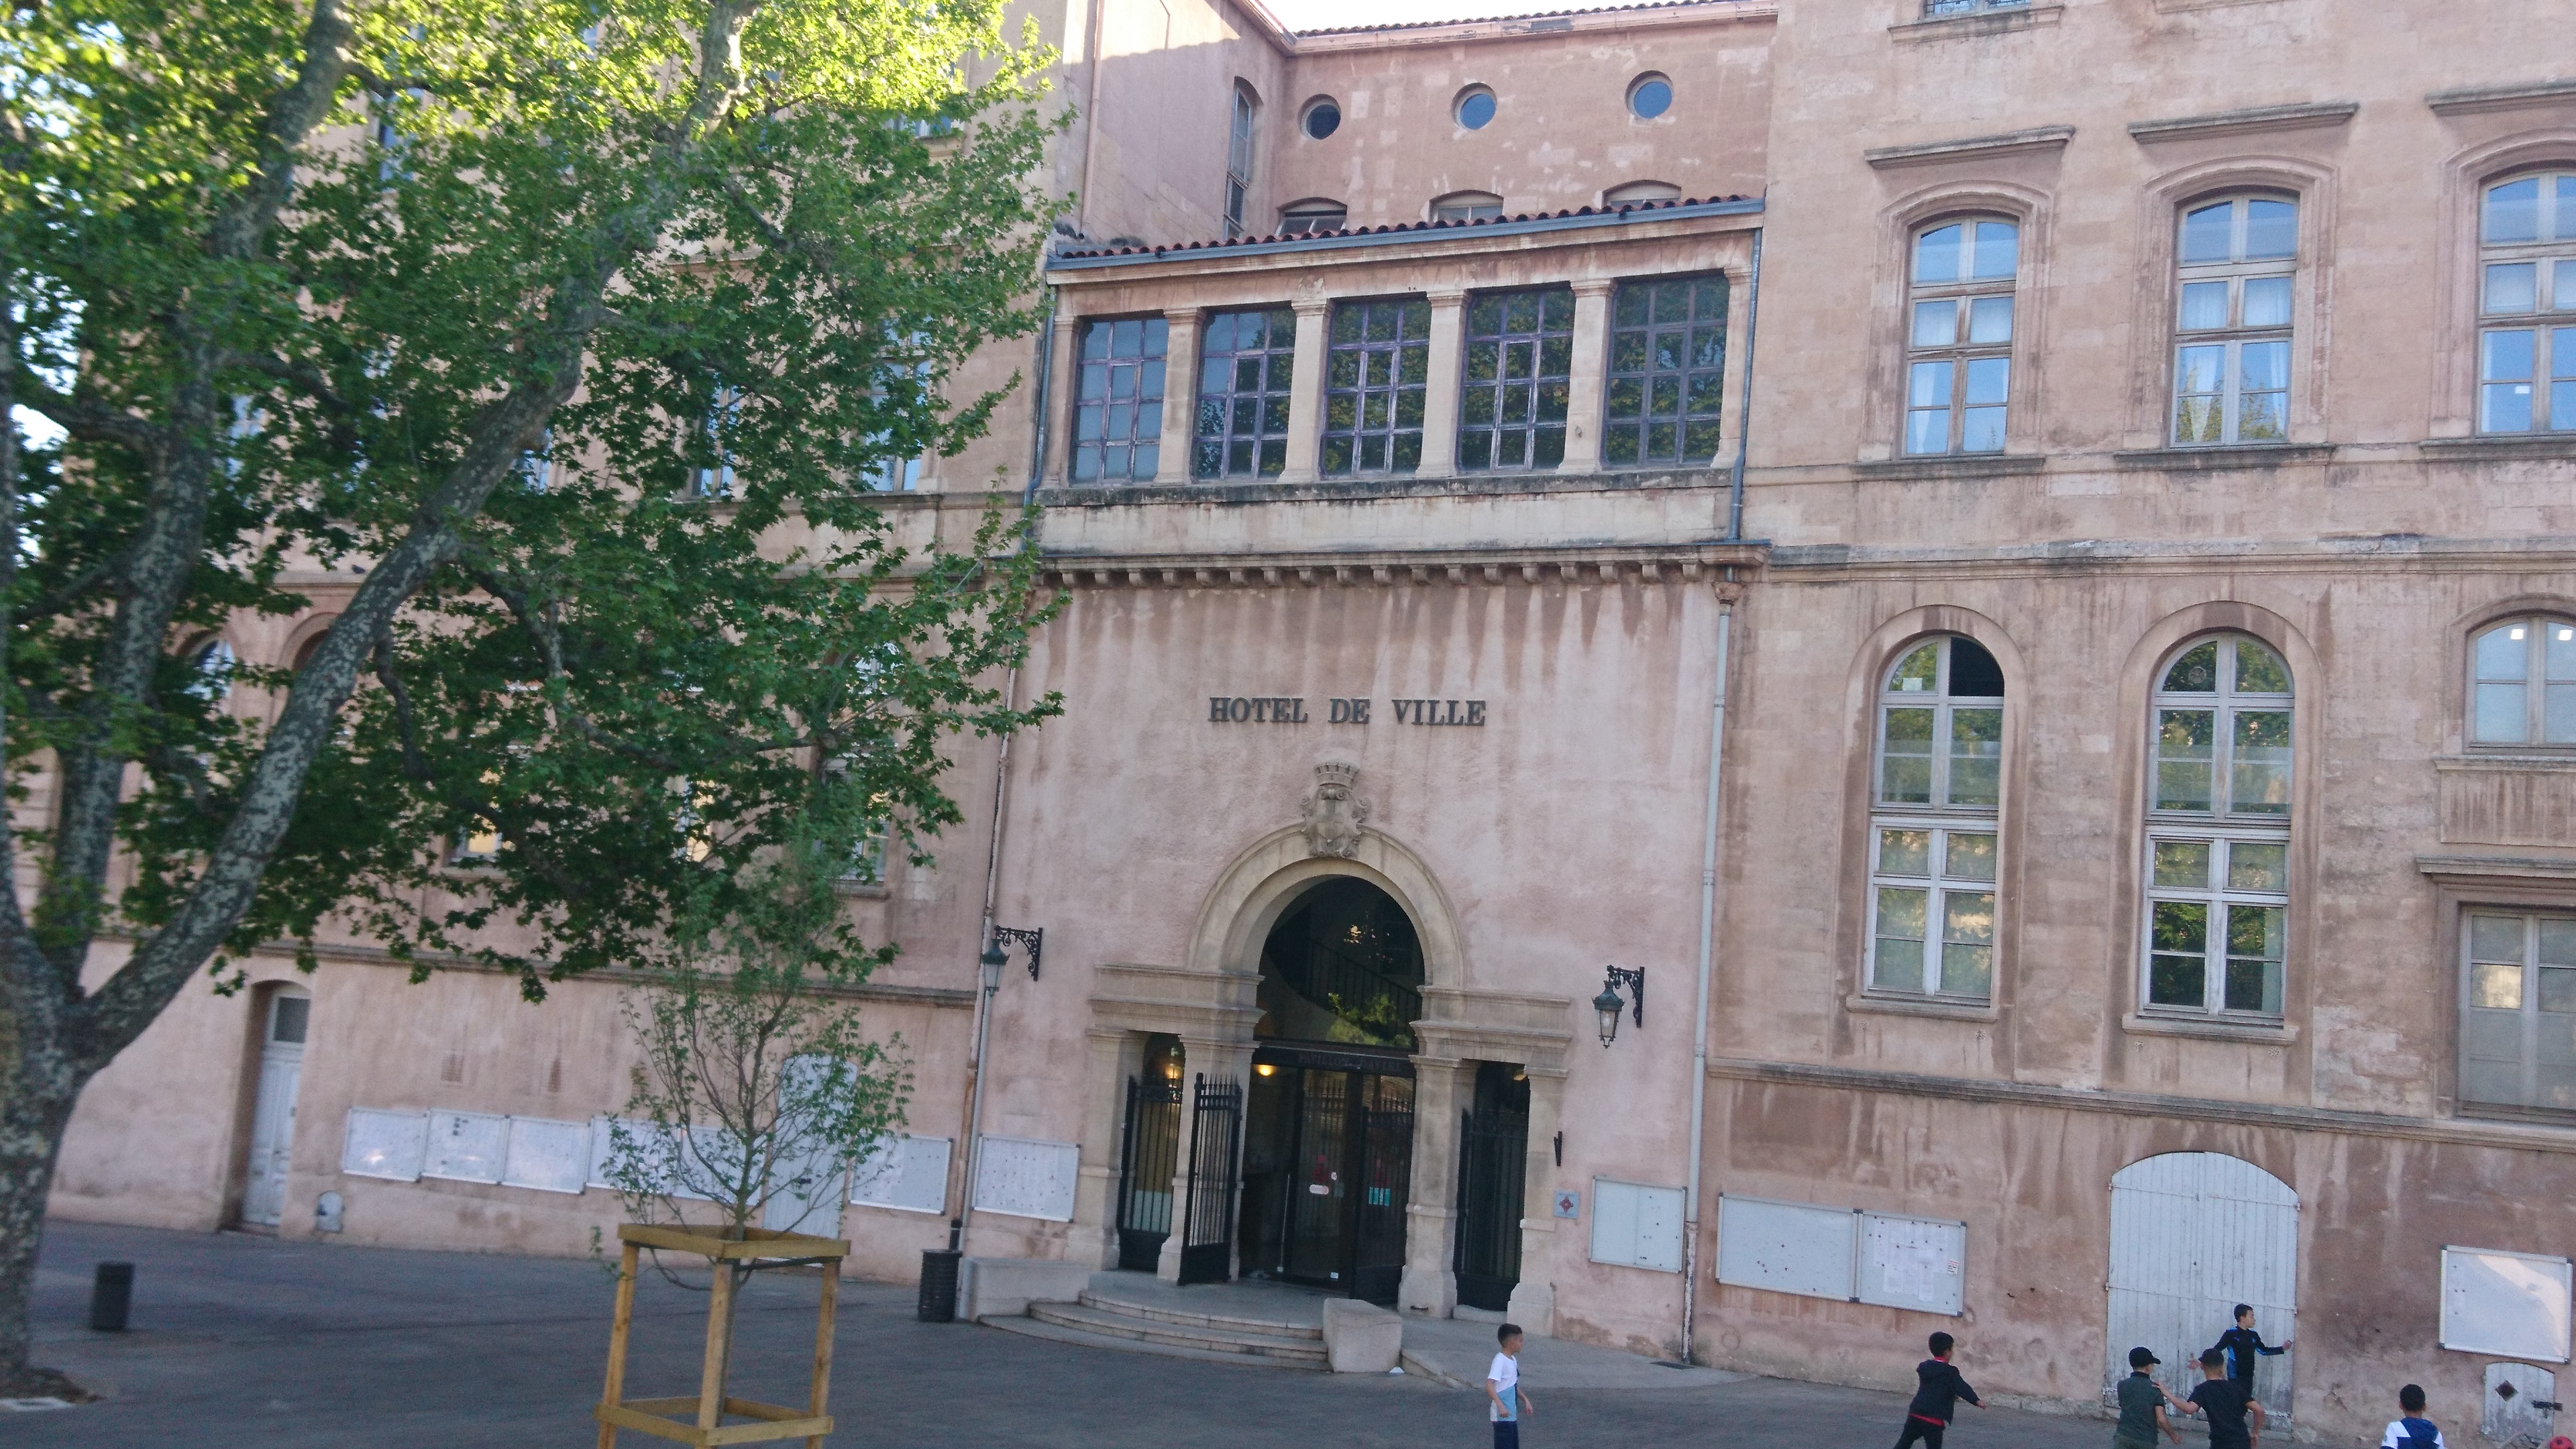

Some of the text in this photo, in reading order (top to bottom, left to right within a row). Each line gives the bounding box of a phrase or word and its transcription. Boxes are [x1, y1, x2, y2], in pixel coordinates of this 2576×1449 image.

[1208, 696, 1487, 727] HOTEL DE VILLE
[1298, 1053, 1349, 1067] PAVILLON
